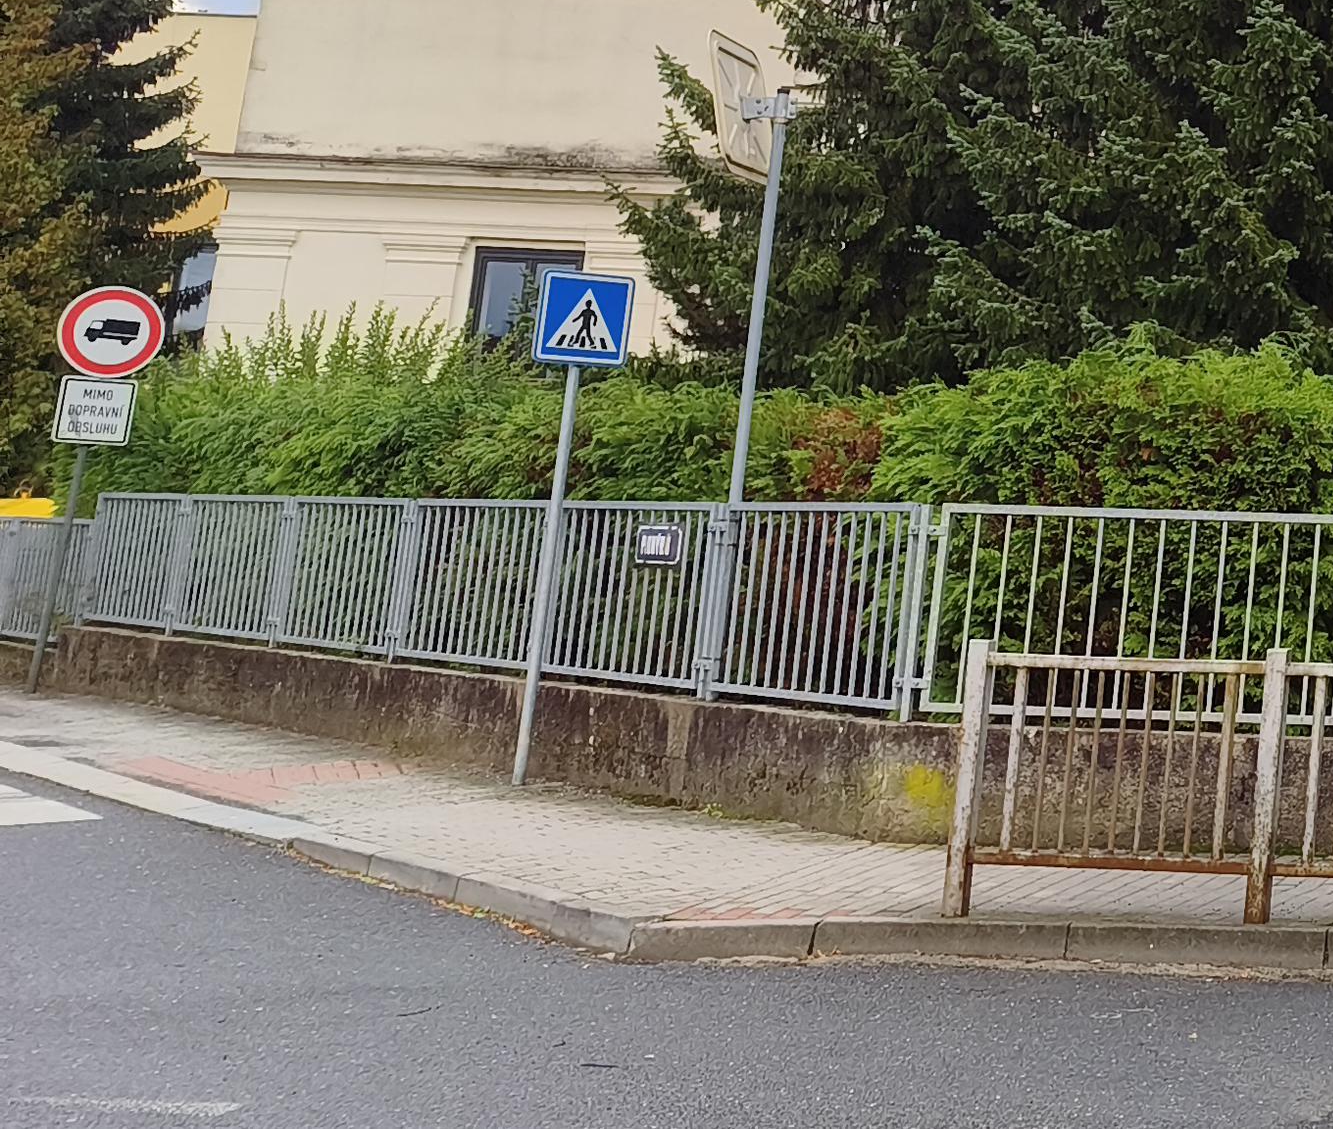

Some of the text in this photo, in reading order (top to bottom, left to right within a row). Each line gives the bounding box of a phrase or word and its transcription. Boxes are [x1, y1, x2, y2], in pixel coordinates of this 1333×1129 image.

[83, 389, 114, 401] MIMO
[67, 404, 126, 419] DOPRAVNÍ
[67, 420, 118, 435] OBSLUHU
